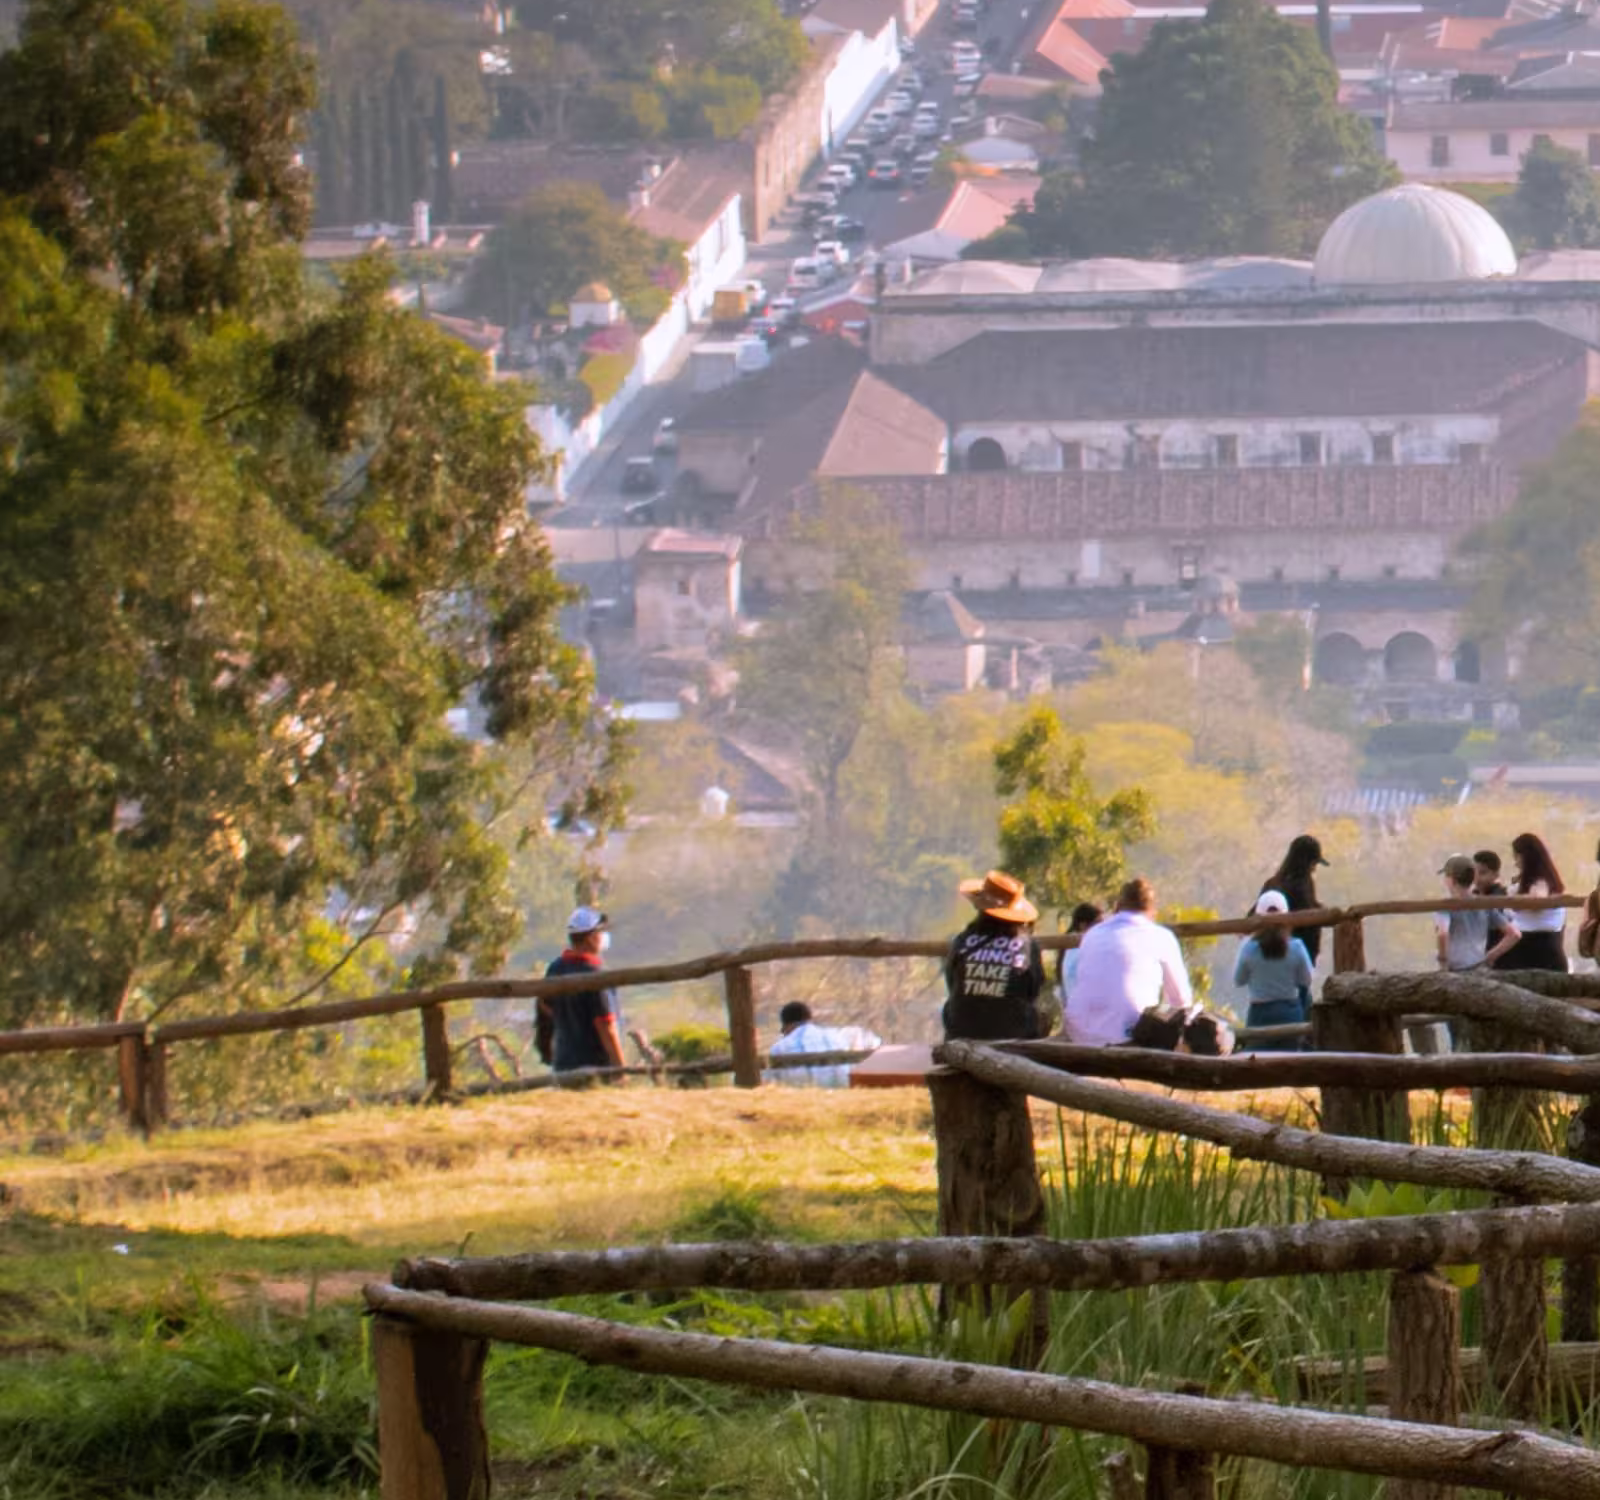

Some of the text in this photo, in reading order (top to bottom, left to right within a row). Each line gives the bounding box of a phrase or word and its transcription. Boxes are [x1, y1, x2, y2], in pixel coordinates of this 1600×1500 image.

[961, 948, 1025, 967] HINGS
[965, 964, 1011, 980] TAKE
[964, 980, 1008, 997] TIME
